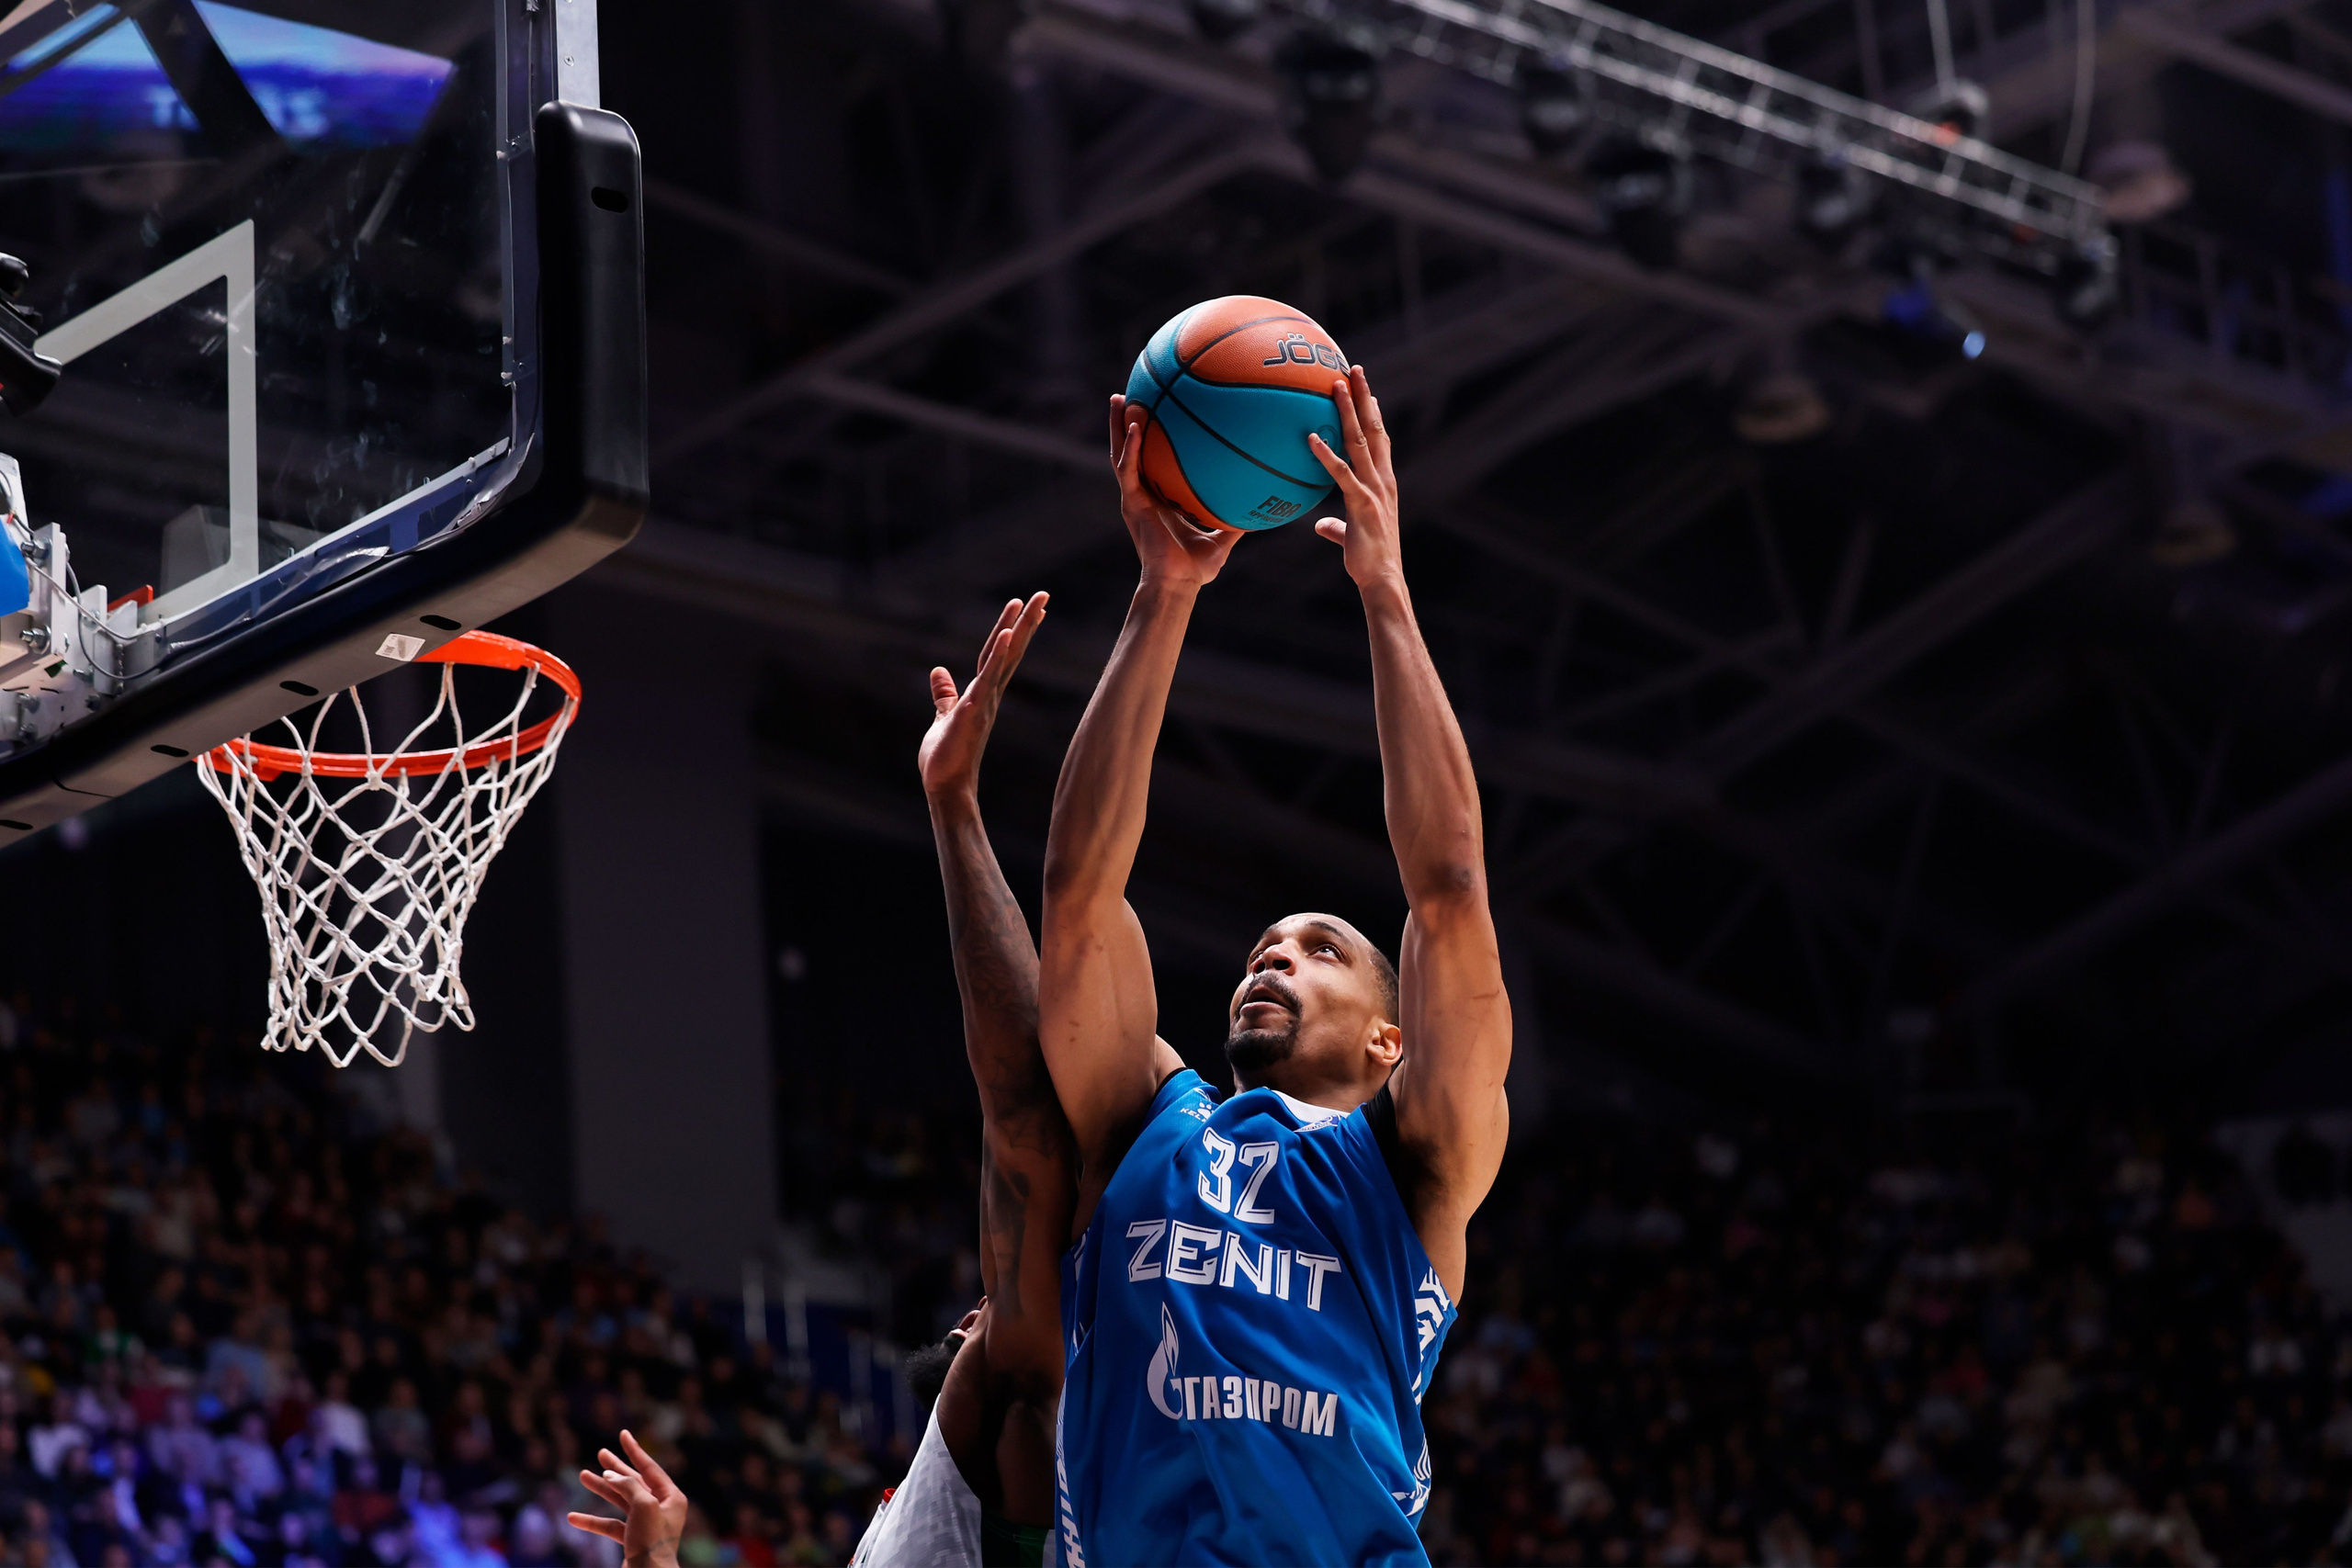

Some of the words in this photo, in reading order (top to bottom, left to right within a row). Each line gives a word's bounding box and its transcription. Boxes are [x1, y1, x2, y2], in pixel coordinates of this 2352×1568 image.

[1263, 333, 1351, 378] JÖGE
[1257, 495, 1302, 517] FIBA
[1180, 1108, 1207, 1122] KEL
[1199, 1126, 1280, 1224] 32
[1125, 1219, 1341, 1312] ZENIT
[1183, 1375, 1339, 1437] ГАЗПРОМ
